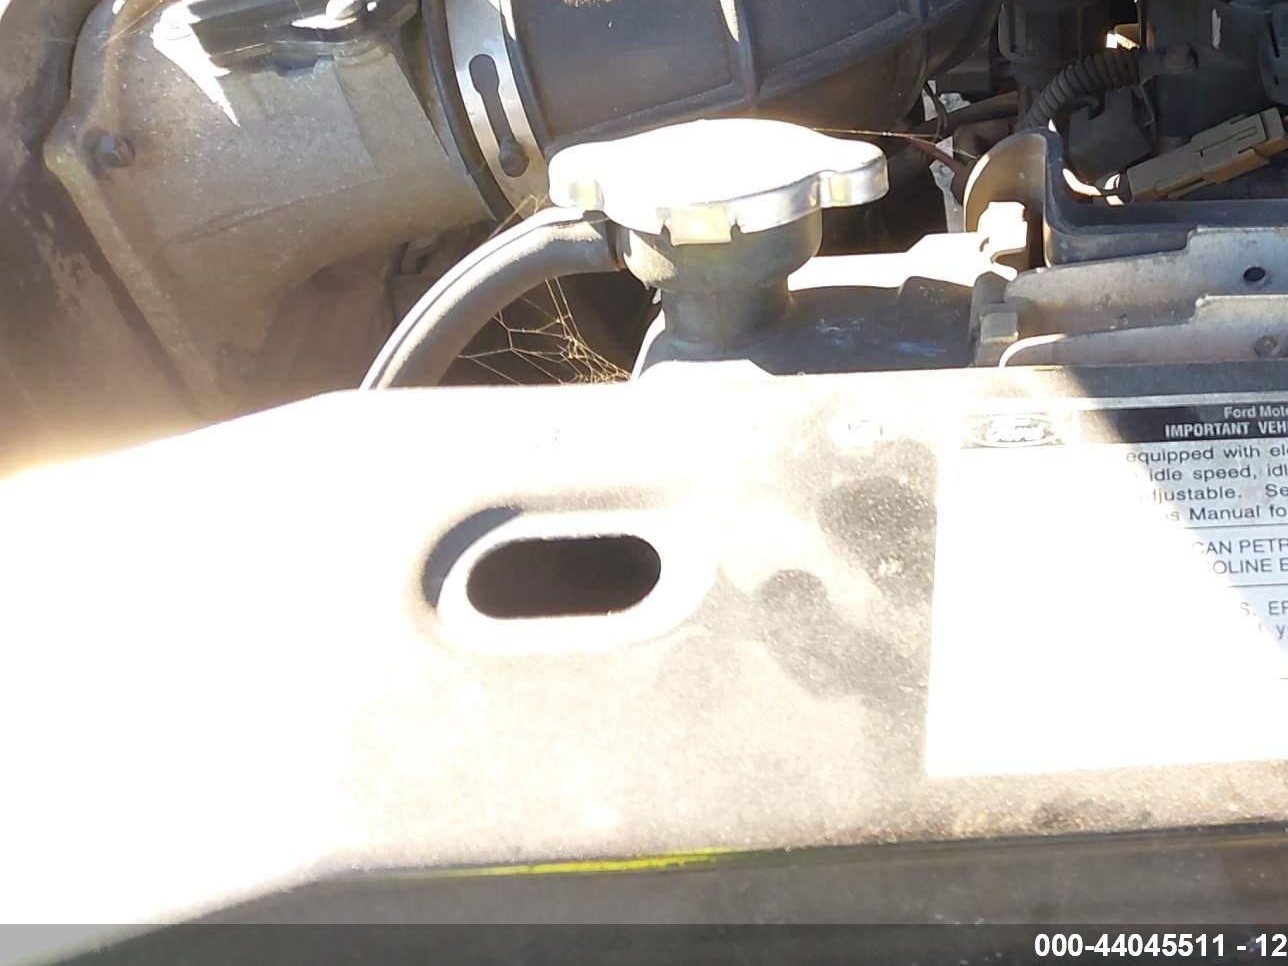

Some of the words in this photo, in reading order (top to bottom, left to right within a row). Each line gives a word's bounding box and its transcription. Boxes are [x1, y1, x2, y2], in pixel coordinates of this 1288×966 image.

[1223, 405, 1256, 419] Ford
[1164, 422, 1250, 438] IMPORTANT
[1126, 446, 1214, 465] equipped
[1223, 444, 1260, 459] with
[1150, 468, 1183, 482] idle
[1193, 465, 1257, 482] speed,
[1189, 505, 1261, 521] Manual
